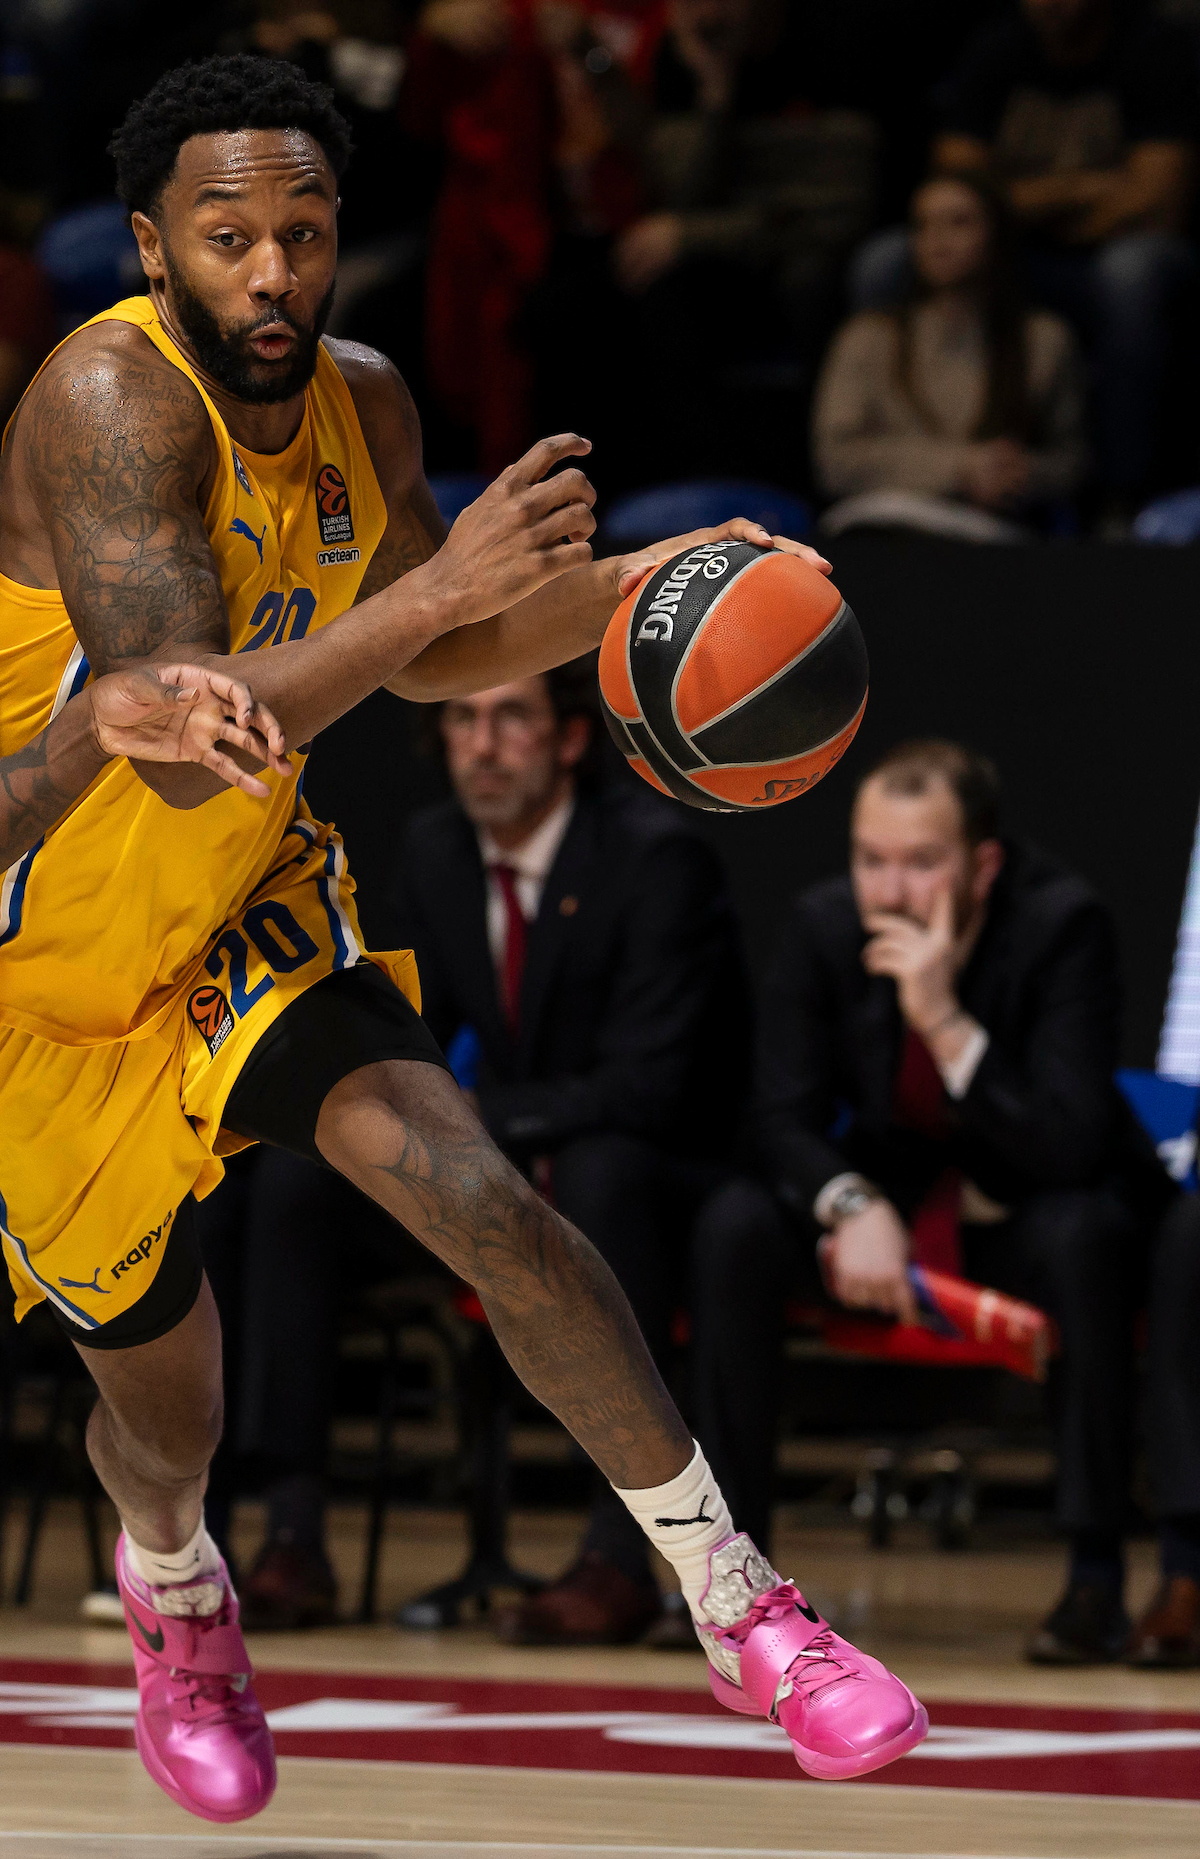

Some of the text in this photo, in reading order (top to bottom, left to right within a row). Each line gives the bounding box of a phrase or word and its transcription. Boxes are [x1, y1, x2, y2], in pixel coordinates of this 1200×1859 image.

[321, 514, 350, 526] TURKISH
[323, 522, 351, 534] AIRLINES
[318, 548, 360, 566] oneteam
[238, 586, 317, 654] 20
[204, 899, 320, 1020] 20
